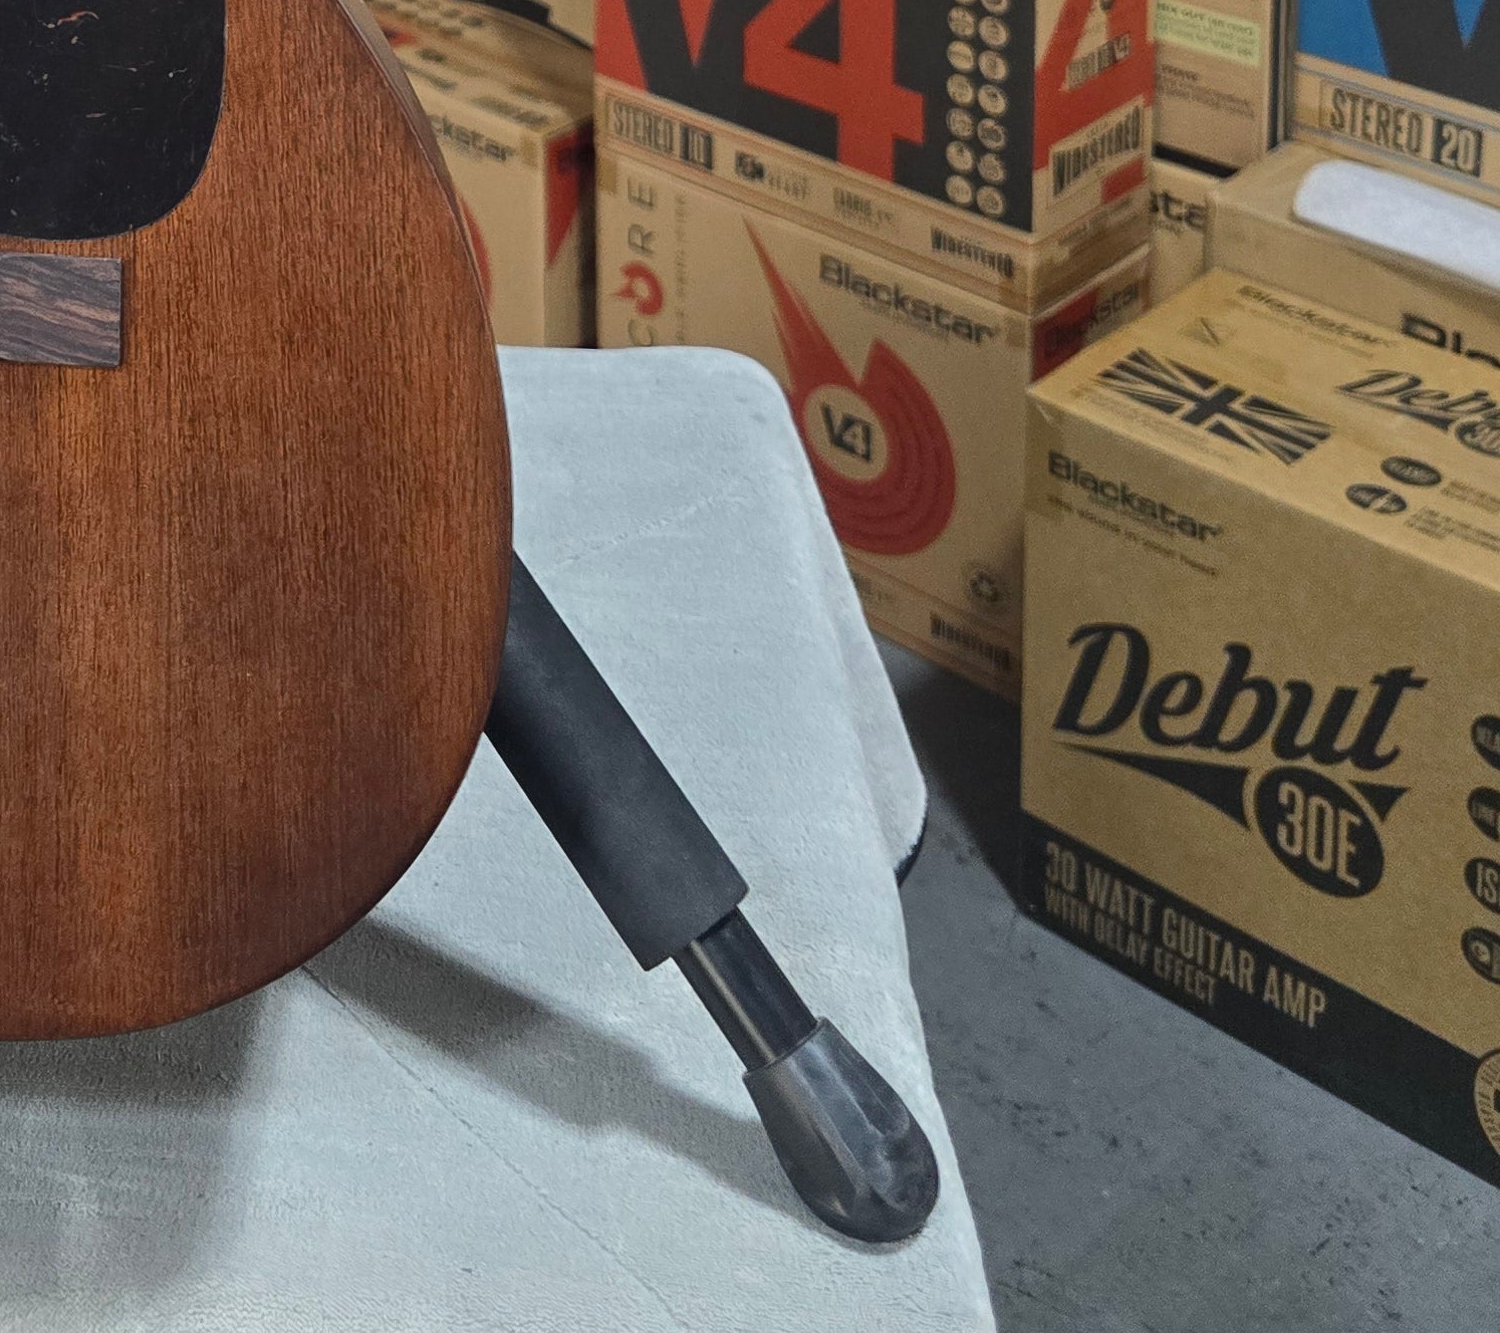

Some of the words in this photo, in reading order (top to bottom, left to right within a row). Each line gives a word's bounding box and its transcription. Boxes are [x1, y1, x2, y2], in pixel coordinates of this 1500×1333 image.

[613, 99, 674, 155] STEREO
[1330, 87, 1423, 154] STEREO
[1440, 122, 1476, 172] 20
[819, 252, 1000, 346] Blackstar
[1048, 450, 1222, 542] Blackstar
[1052, 620, 1431, 772] Debut
[1277, 780, 1365, 889] 30E
[1044, 885, 1090, 934] WITH
[1094, 910, 1150, 968] DELAY
[1153, 945, 1217, 1008] EFFECT
[1045, 840, 1077, 894] 30
[1084, 860, 1156, 935] WATT
[1161, 906, 1256, 996] GUITAR
[1262, 964, 1327, 1030] AMP
